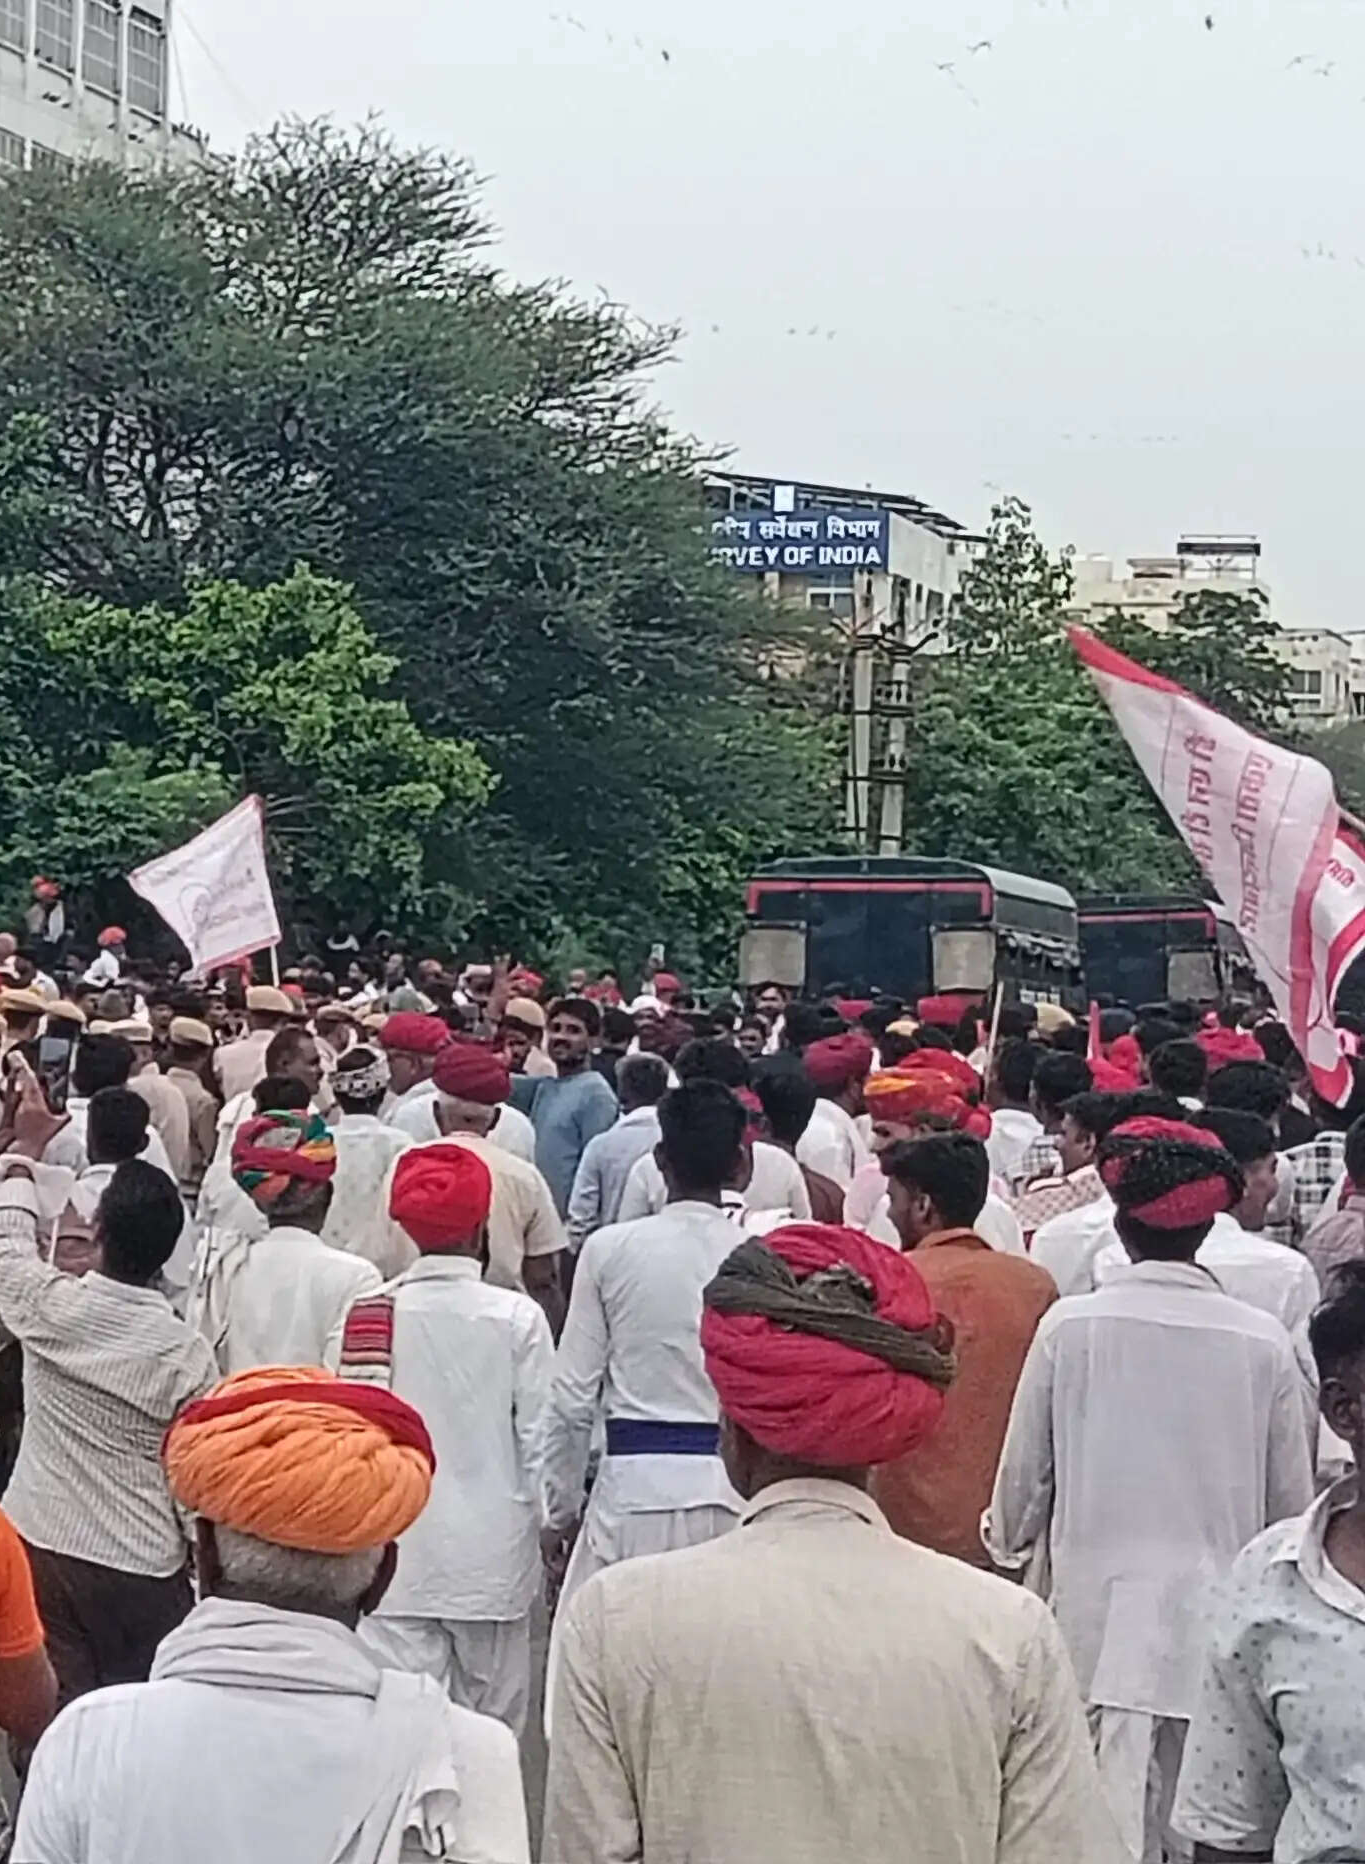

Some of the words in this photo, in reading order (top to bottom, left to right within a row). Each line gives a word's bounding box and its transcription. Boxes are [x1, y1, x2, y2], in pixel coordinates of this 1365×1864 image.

[827, 515, 880, 539] विभाग
[703, 547, 779, 566] RVEY
[784, 547, 815, 565] OF
[819, 546, 882, 565] INDIA
